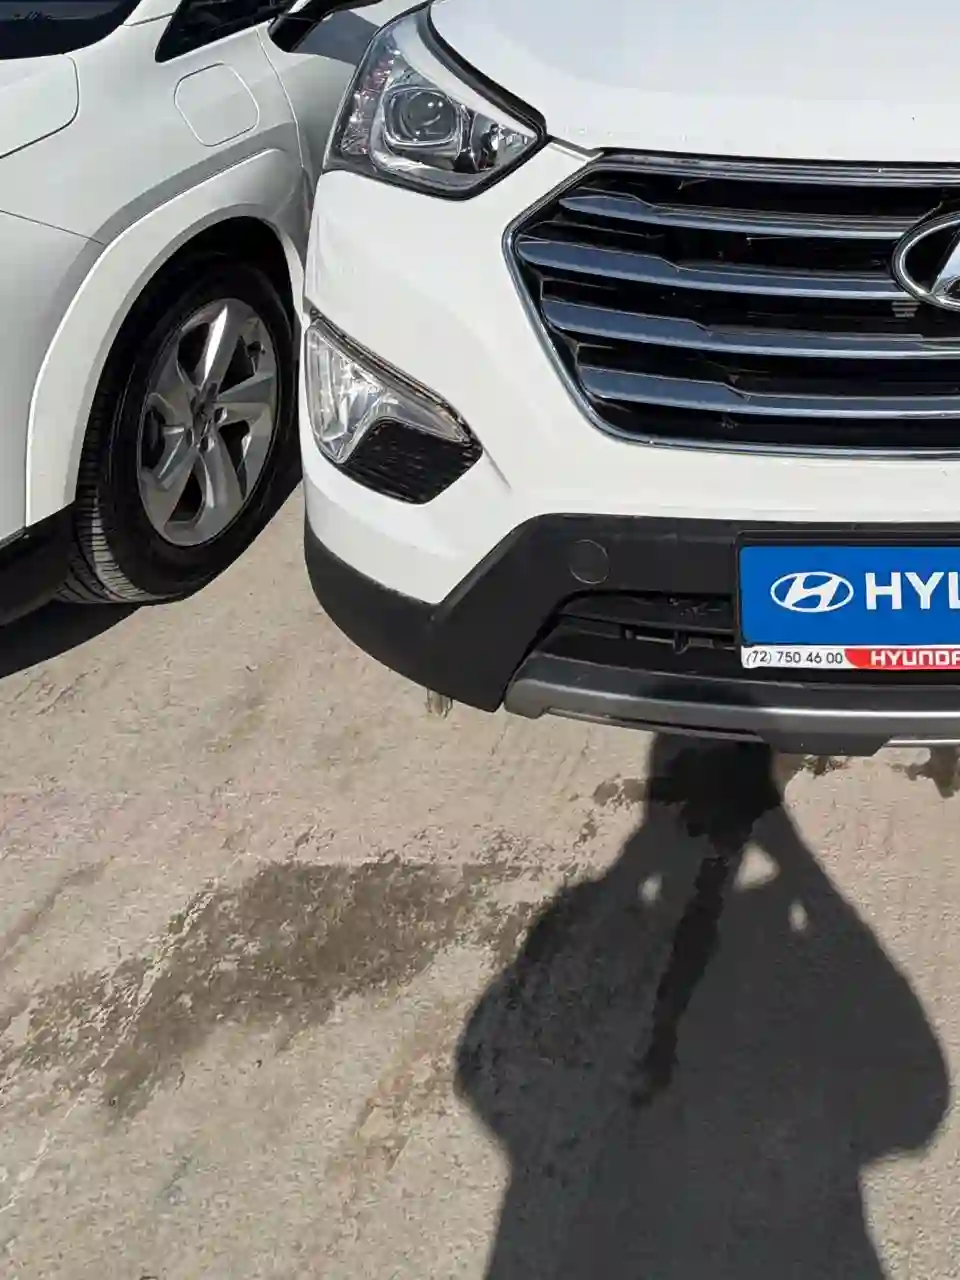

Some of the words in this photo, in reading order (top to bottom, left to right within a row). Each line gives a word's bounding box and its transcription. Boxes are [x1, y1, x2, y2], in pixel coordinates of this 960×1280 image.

[777, 651, 801, 664] 750
[806, 651, 822, 664] 46
[826, 651, 844, 664] 00
